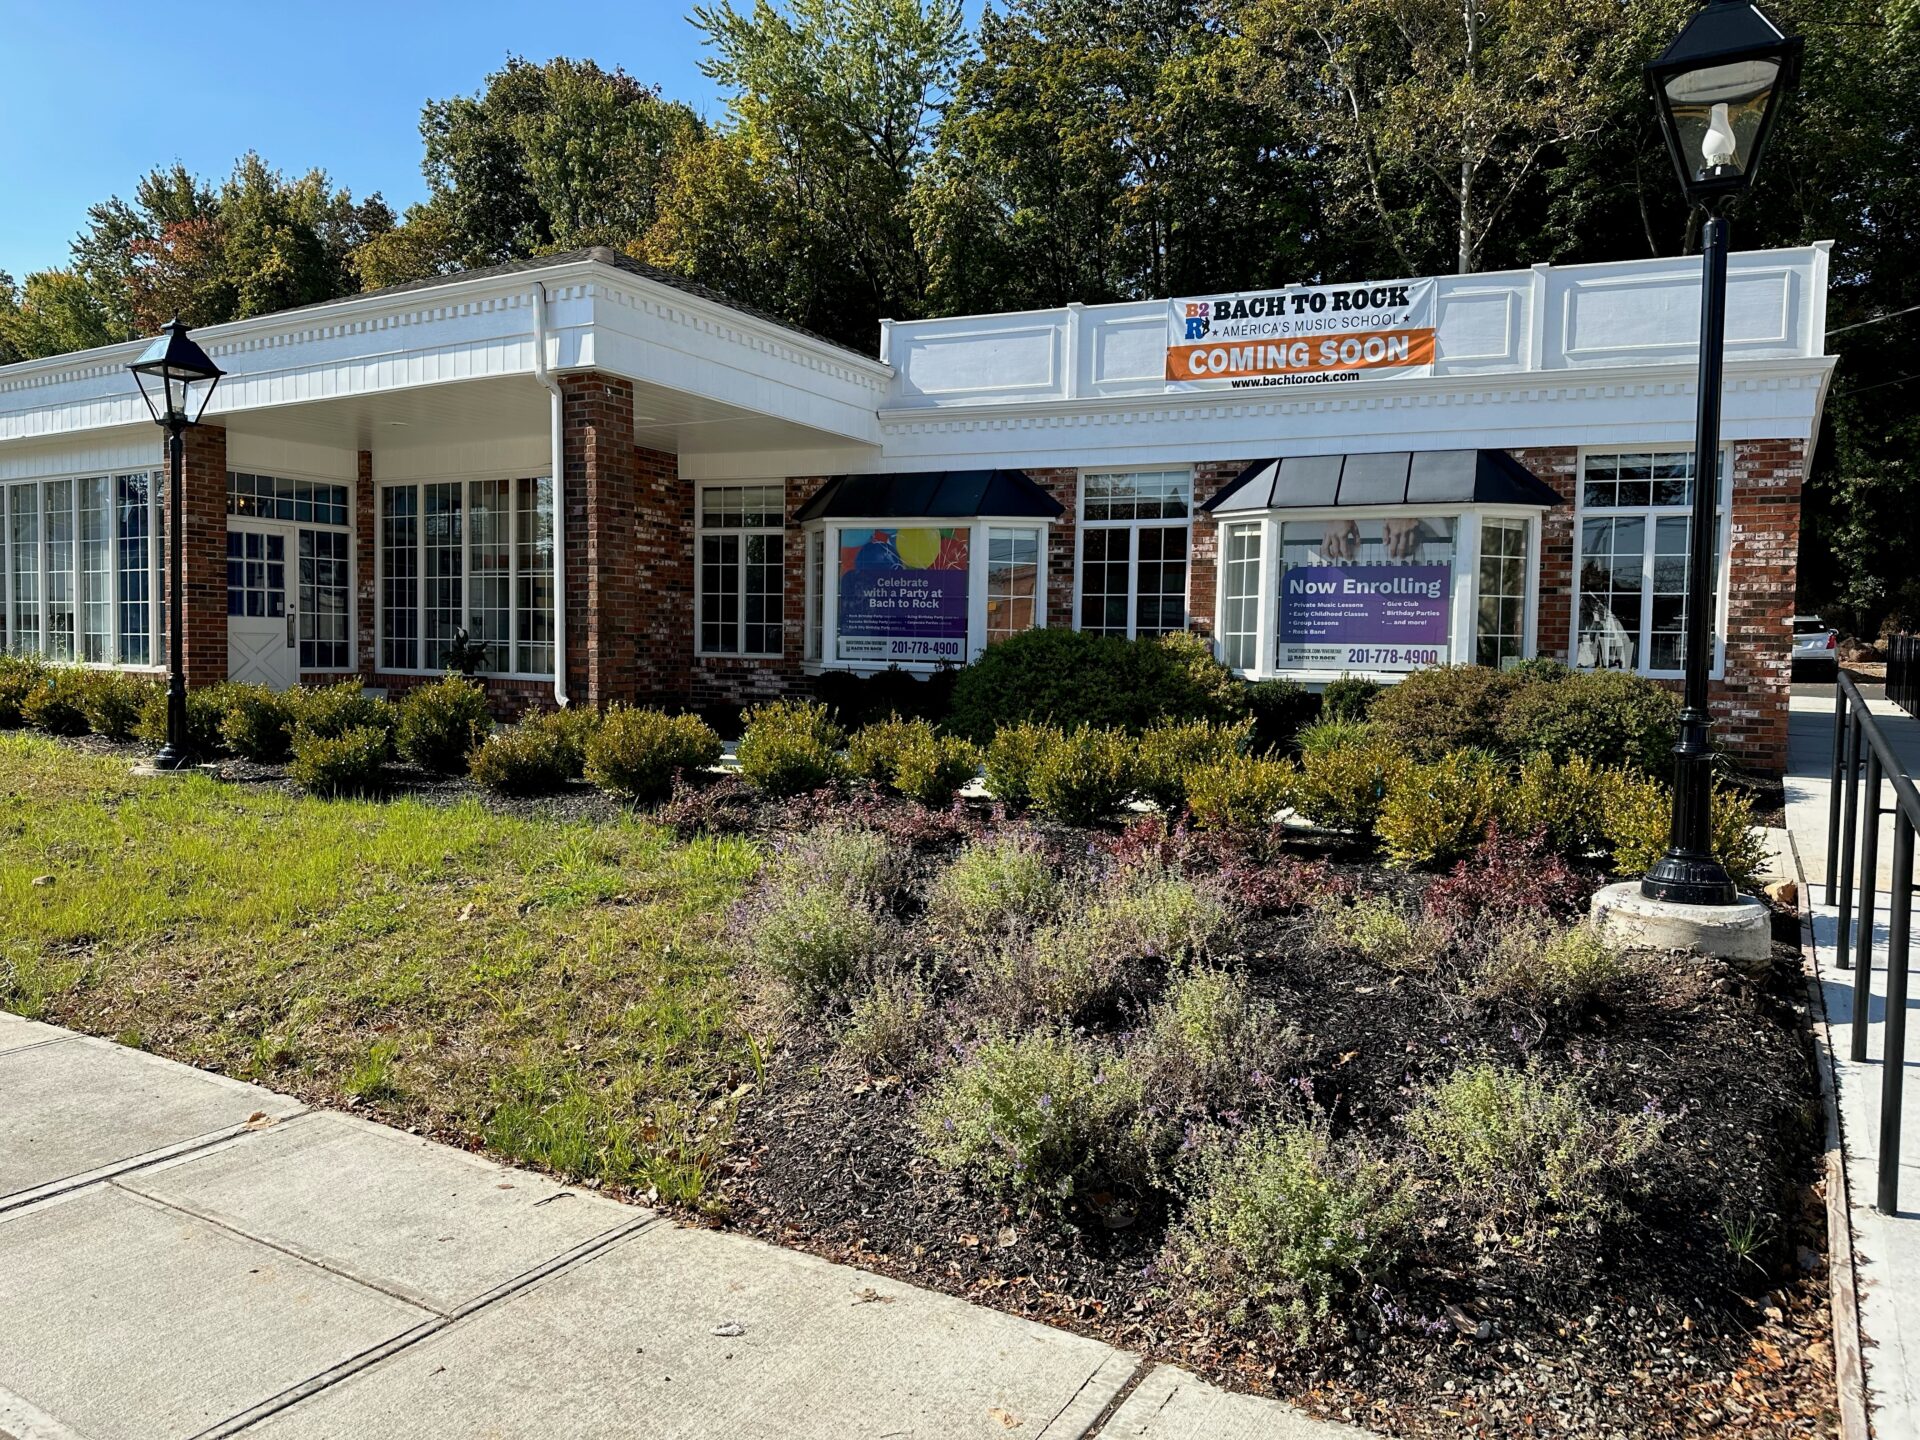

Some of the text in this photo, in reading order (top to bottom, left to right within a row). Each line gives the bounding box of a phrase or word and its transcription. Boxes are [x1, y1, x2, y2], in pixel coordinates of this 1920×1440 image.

[1213, 286, 1410, 321] BACH TO ROCK
[1222, 314, 1399, 337] AMERICA'S MUSIC SCHOOL
[1188, 335, 1409, 375] COMING SOON
[1231, 371, 1359, 388] www.bachtorock.com
[877, 577, 929, 587] Celebrate
[1289, 577, 1442, 599] Now Enrolling
[863, 588, 888, 598] with
[899, 588, 929, 600] Party
[931, 589, 943, 598] at
[869, 598, 940, 609] Bach to Rock
[891, 640, 959, 655] 201-778-4900
[1348, 648, 1438, 665] 201-778-4900
